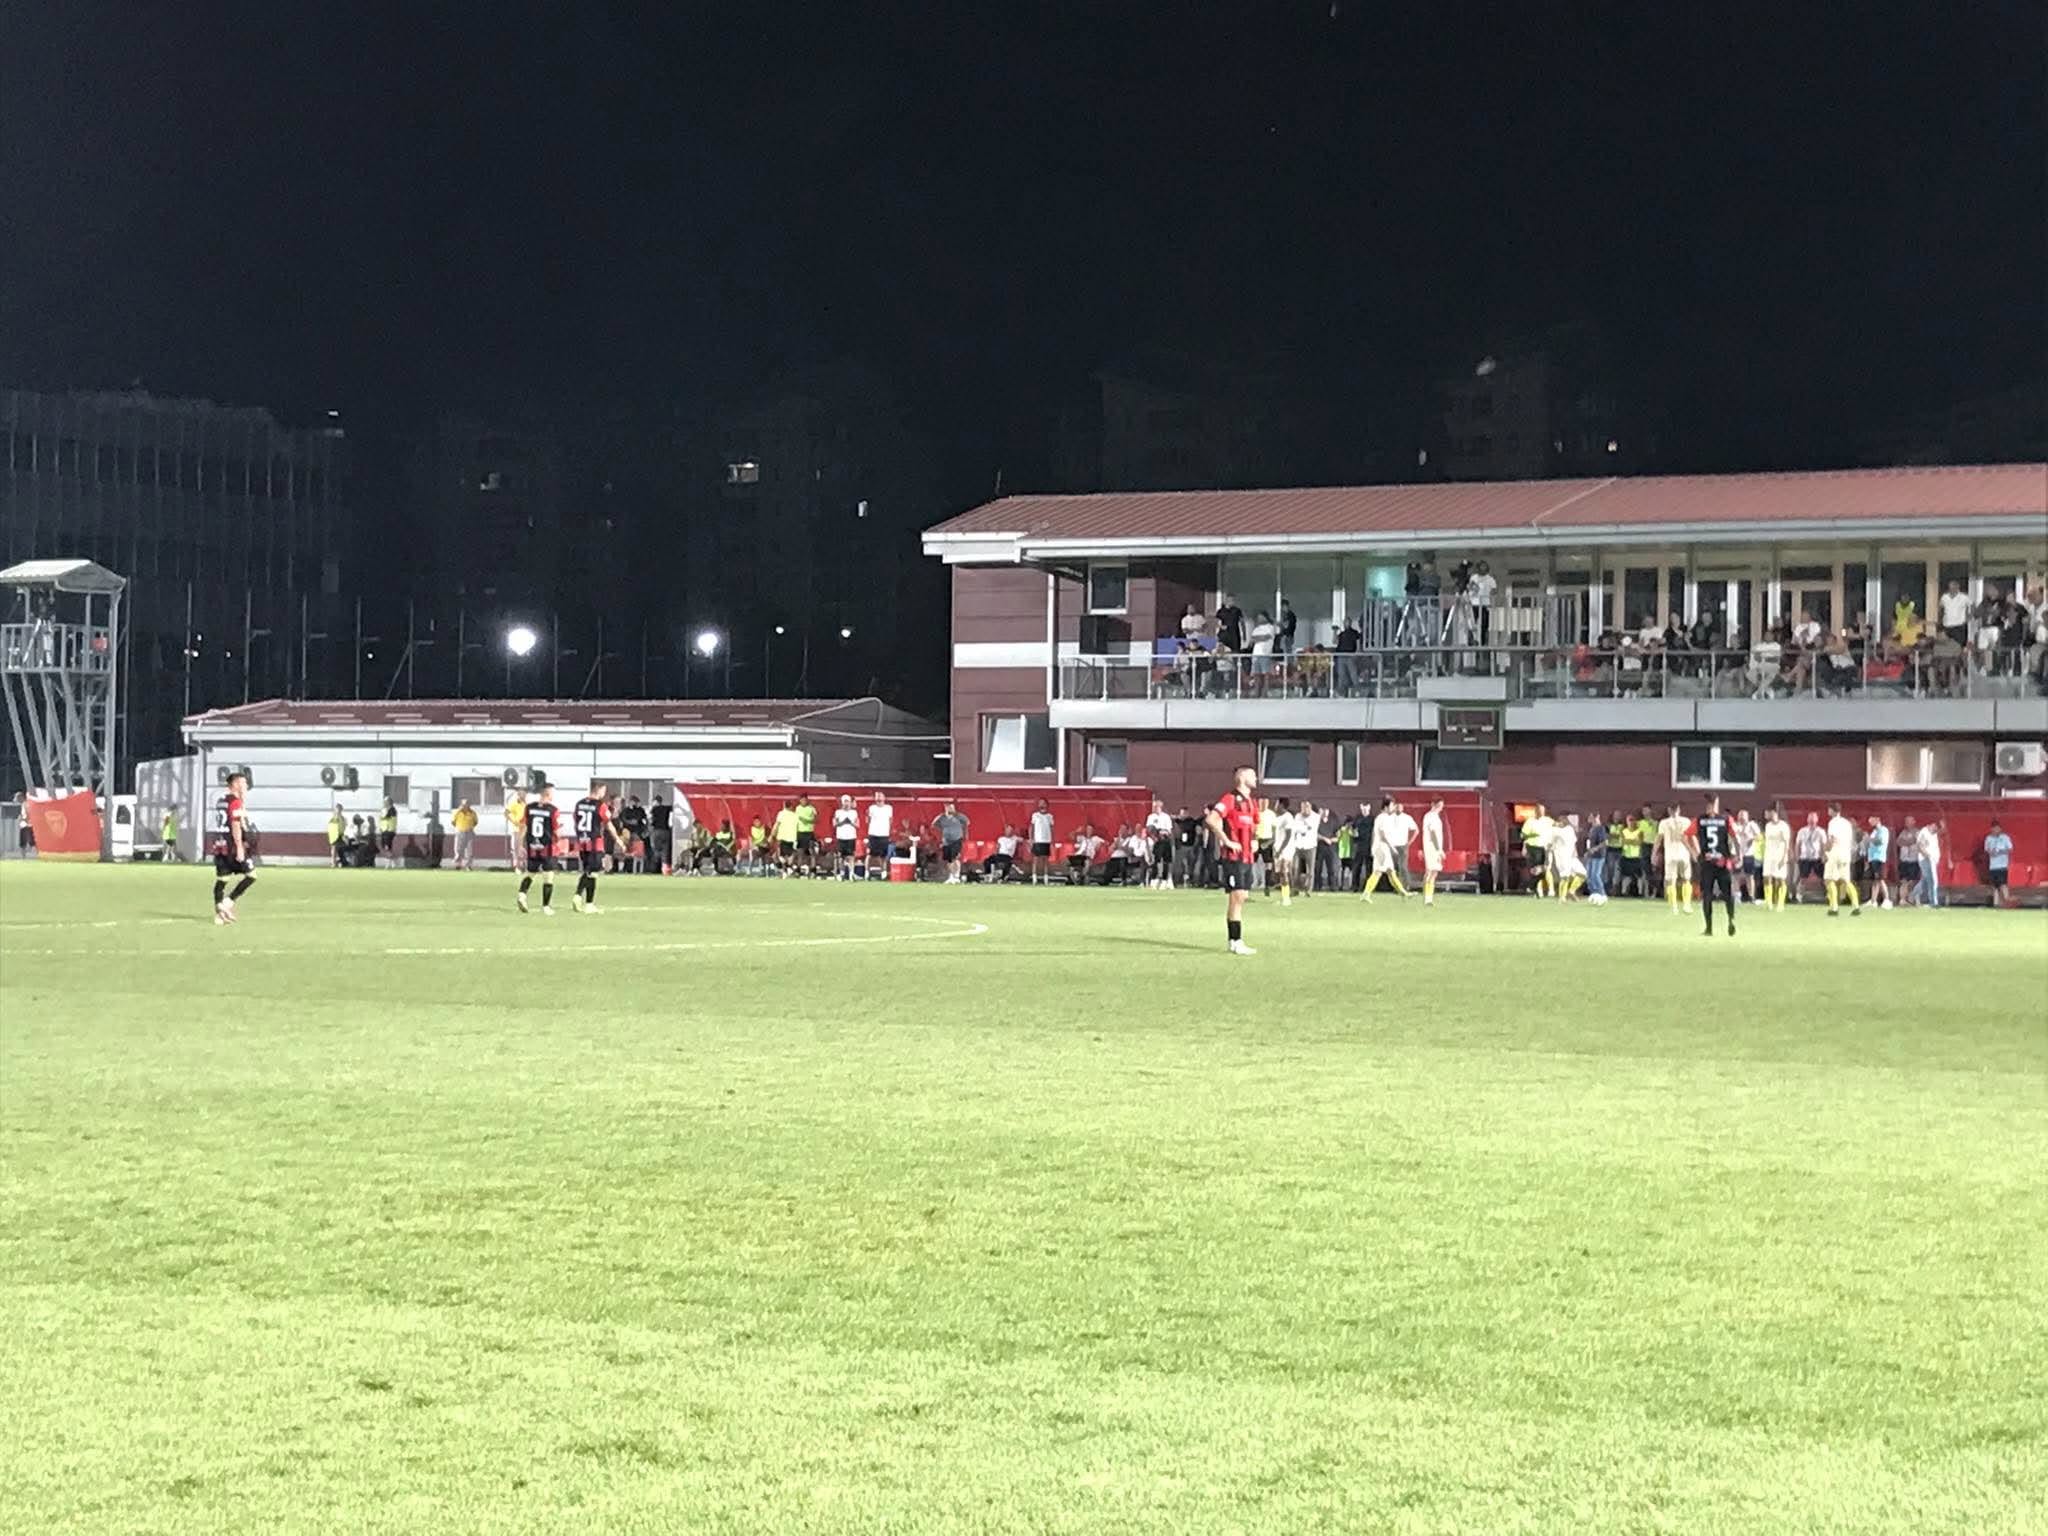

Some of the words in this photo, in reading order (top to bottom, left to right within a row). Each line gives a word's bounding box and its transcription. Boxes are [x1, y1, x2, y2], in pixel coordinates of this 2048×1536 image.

[532, 816, 544, 838] 6
[578, 811, 592, 832] 21
[1706, 826, 1718, 849] 5
